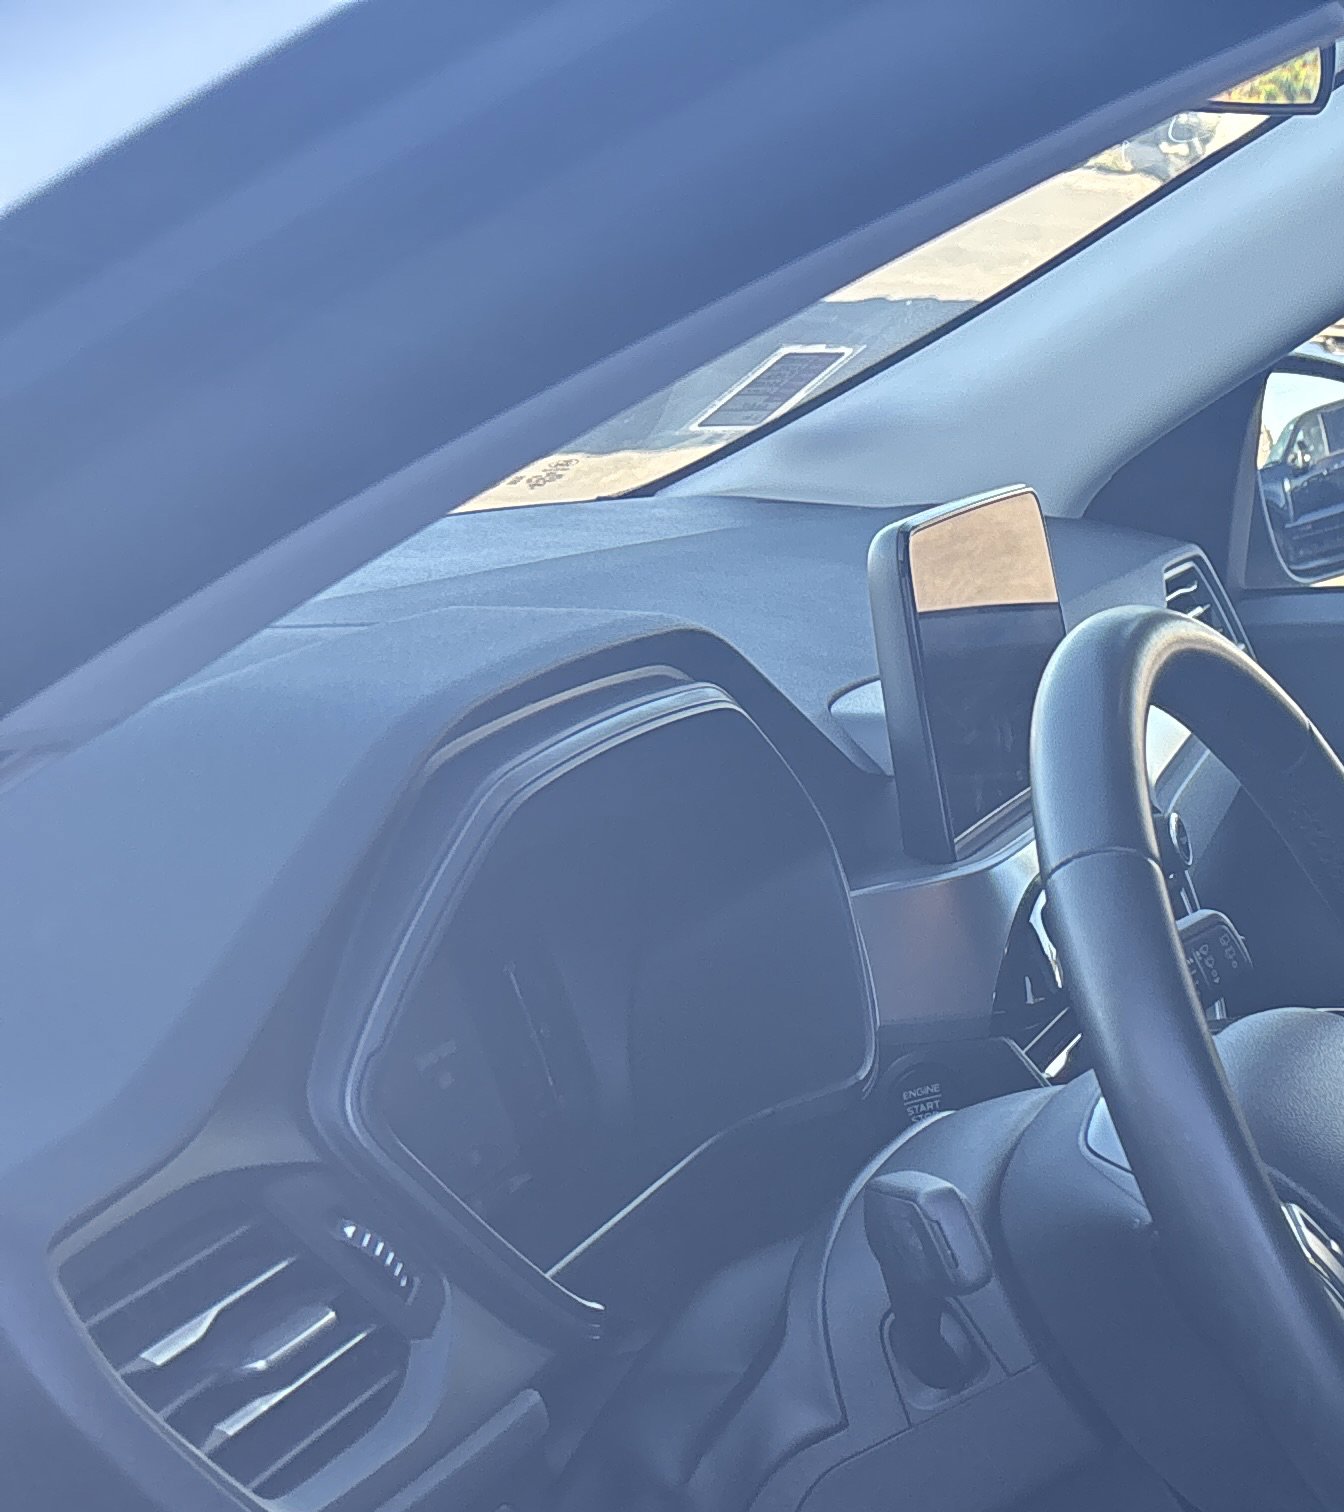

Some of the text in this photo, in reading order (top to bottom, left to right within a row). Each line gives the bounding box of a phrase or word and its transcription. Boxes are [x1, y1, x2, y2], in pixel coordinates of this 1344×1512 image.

[902, 1083, 941, 1101] ENGINE
[906, 1100, 941, 1116] START
[911, 1111, 939, 1122] STO
